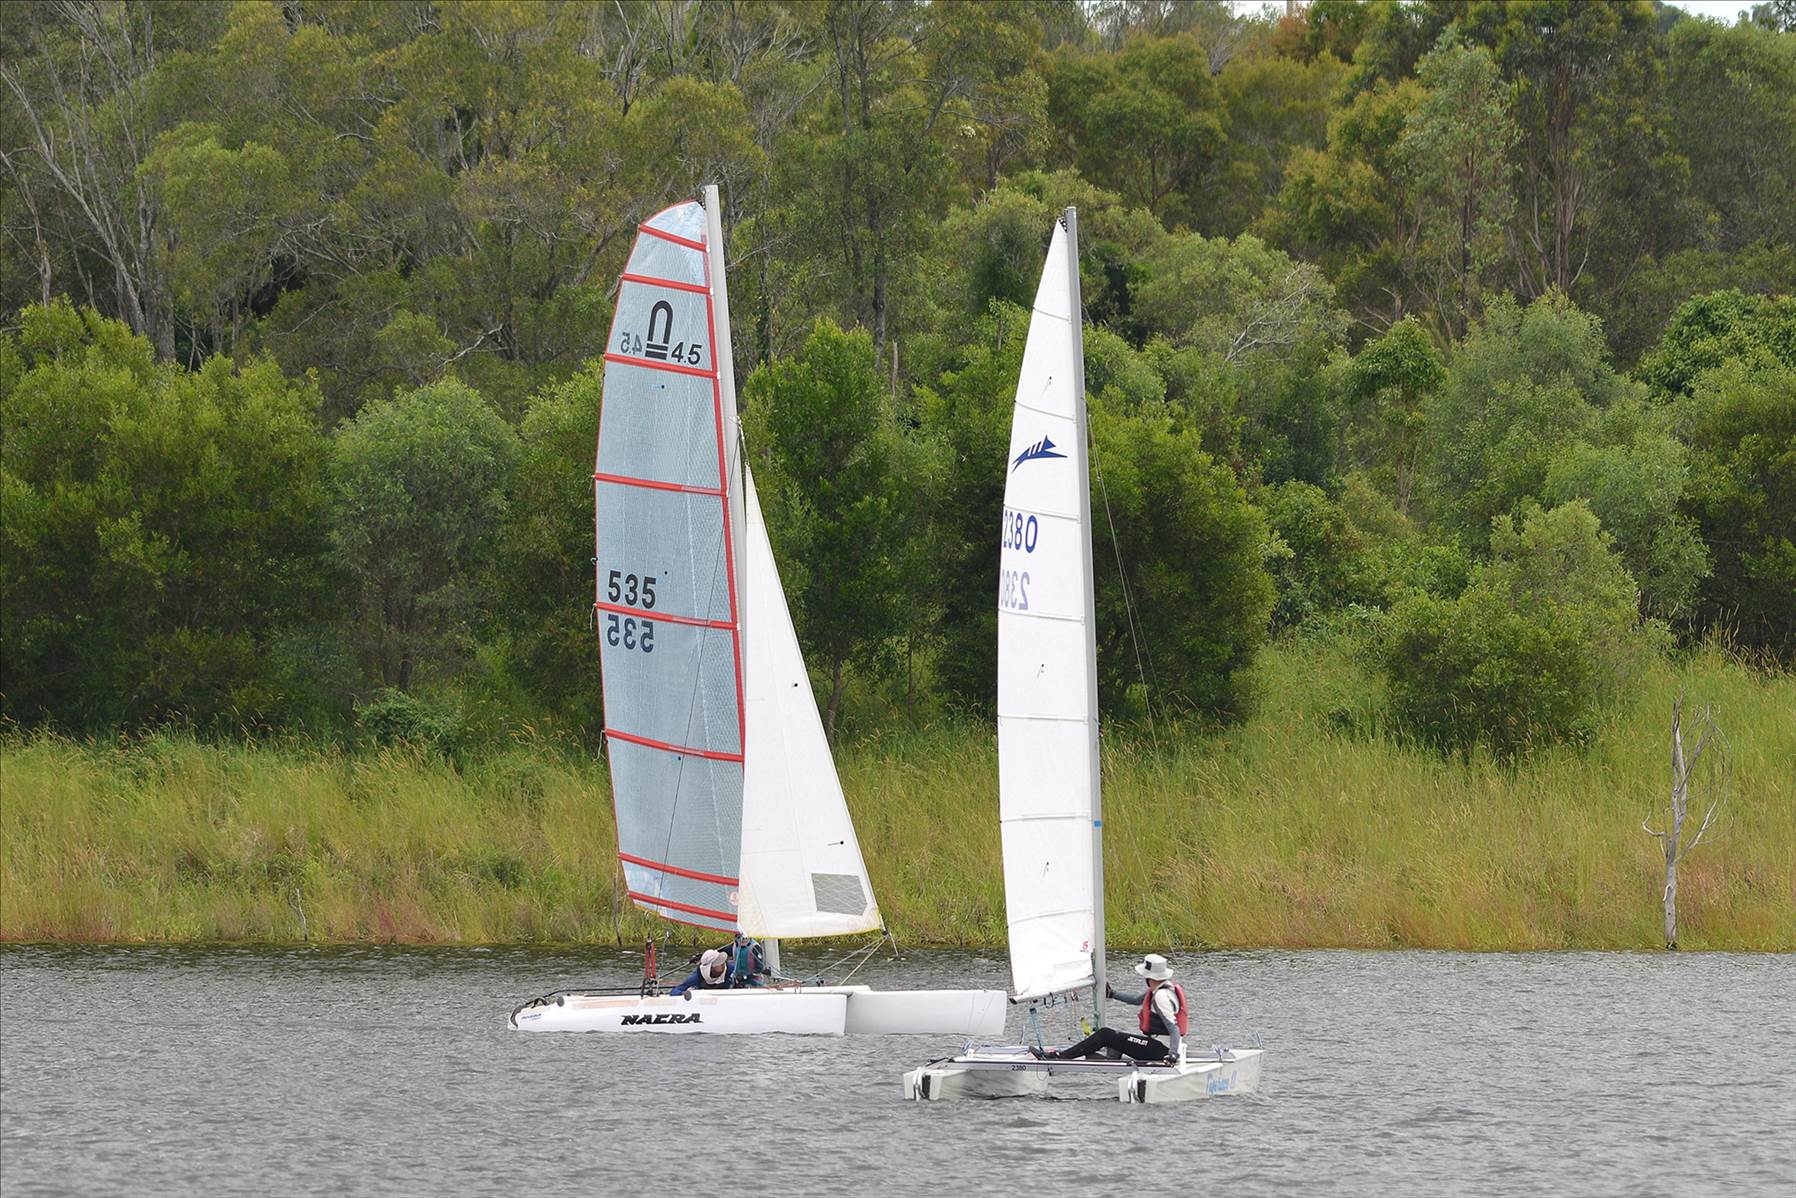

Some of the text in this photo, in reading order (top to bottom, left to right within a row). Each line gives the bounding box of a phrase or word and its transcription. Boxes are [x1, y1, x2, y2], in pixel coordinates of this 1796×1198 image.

[671, 341, 702, 365] 4.5
[1003, 509, 1038, 554] 2380
[607, 570, 657, 609] 535
[620, 1013, 704, 1026] NACRA
